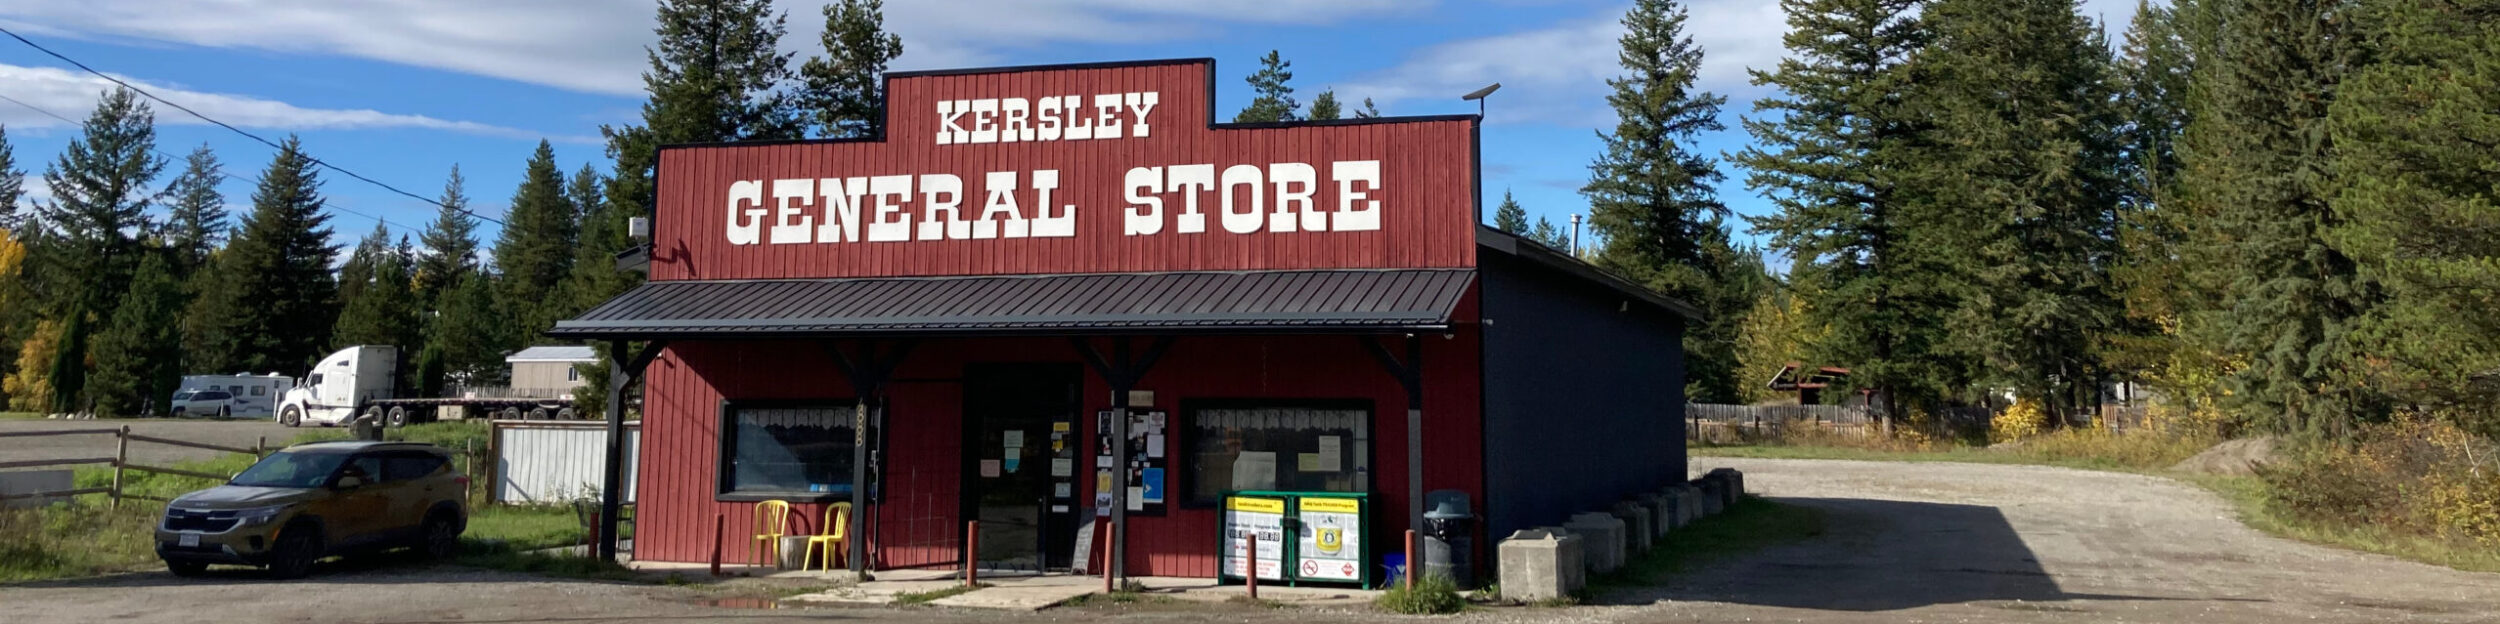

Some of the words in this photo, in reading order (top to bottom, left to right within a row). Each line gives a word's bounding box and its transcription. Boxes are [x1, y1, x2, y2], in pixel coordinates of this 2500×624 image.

[935, 91, 1159, 146] KERSLEY
[726, 169, 1077, 246] GENERAL
[1124, 159, 1382, 236] STORE
